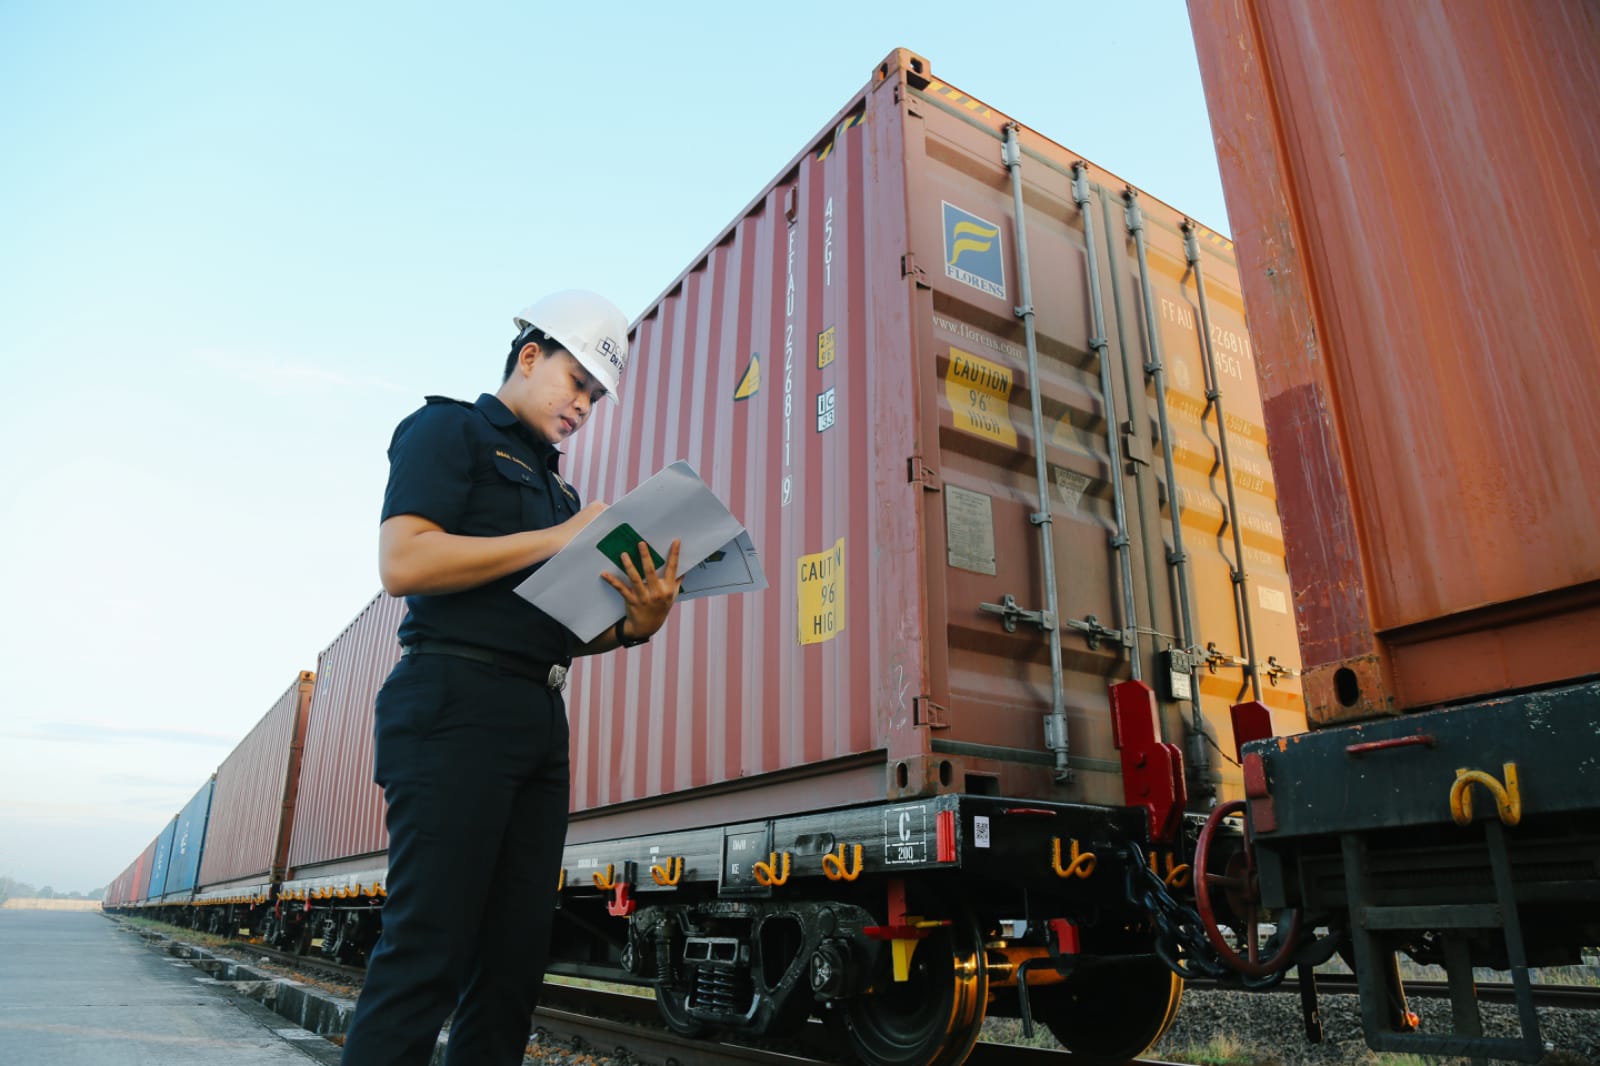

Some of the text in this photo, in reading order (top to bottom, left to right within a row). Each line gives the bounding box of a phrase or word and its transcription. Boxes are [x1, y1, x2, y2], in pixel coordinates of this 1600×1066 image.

[824, 196, 833, 286] 45G1
[786, 230, 796, 317] FFAU
[947, 264, 1004, 297] FLORENS
[1161, 298, 1192, 330] FFAU
[953, 356, 1009, 393] CAUTION
[784, 325, 793, 467] 226811
[968, 409, 1000, 435] HIGH
[800, 547, 841, 583] CAUTN
[813, 611, 833, 635] HIG
[899, 812, 910, 841] C
[898, 846, 913, 860] 200
